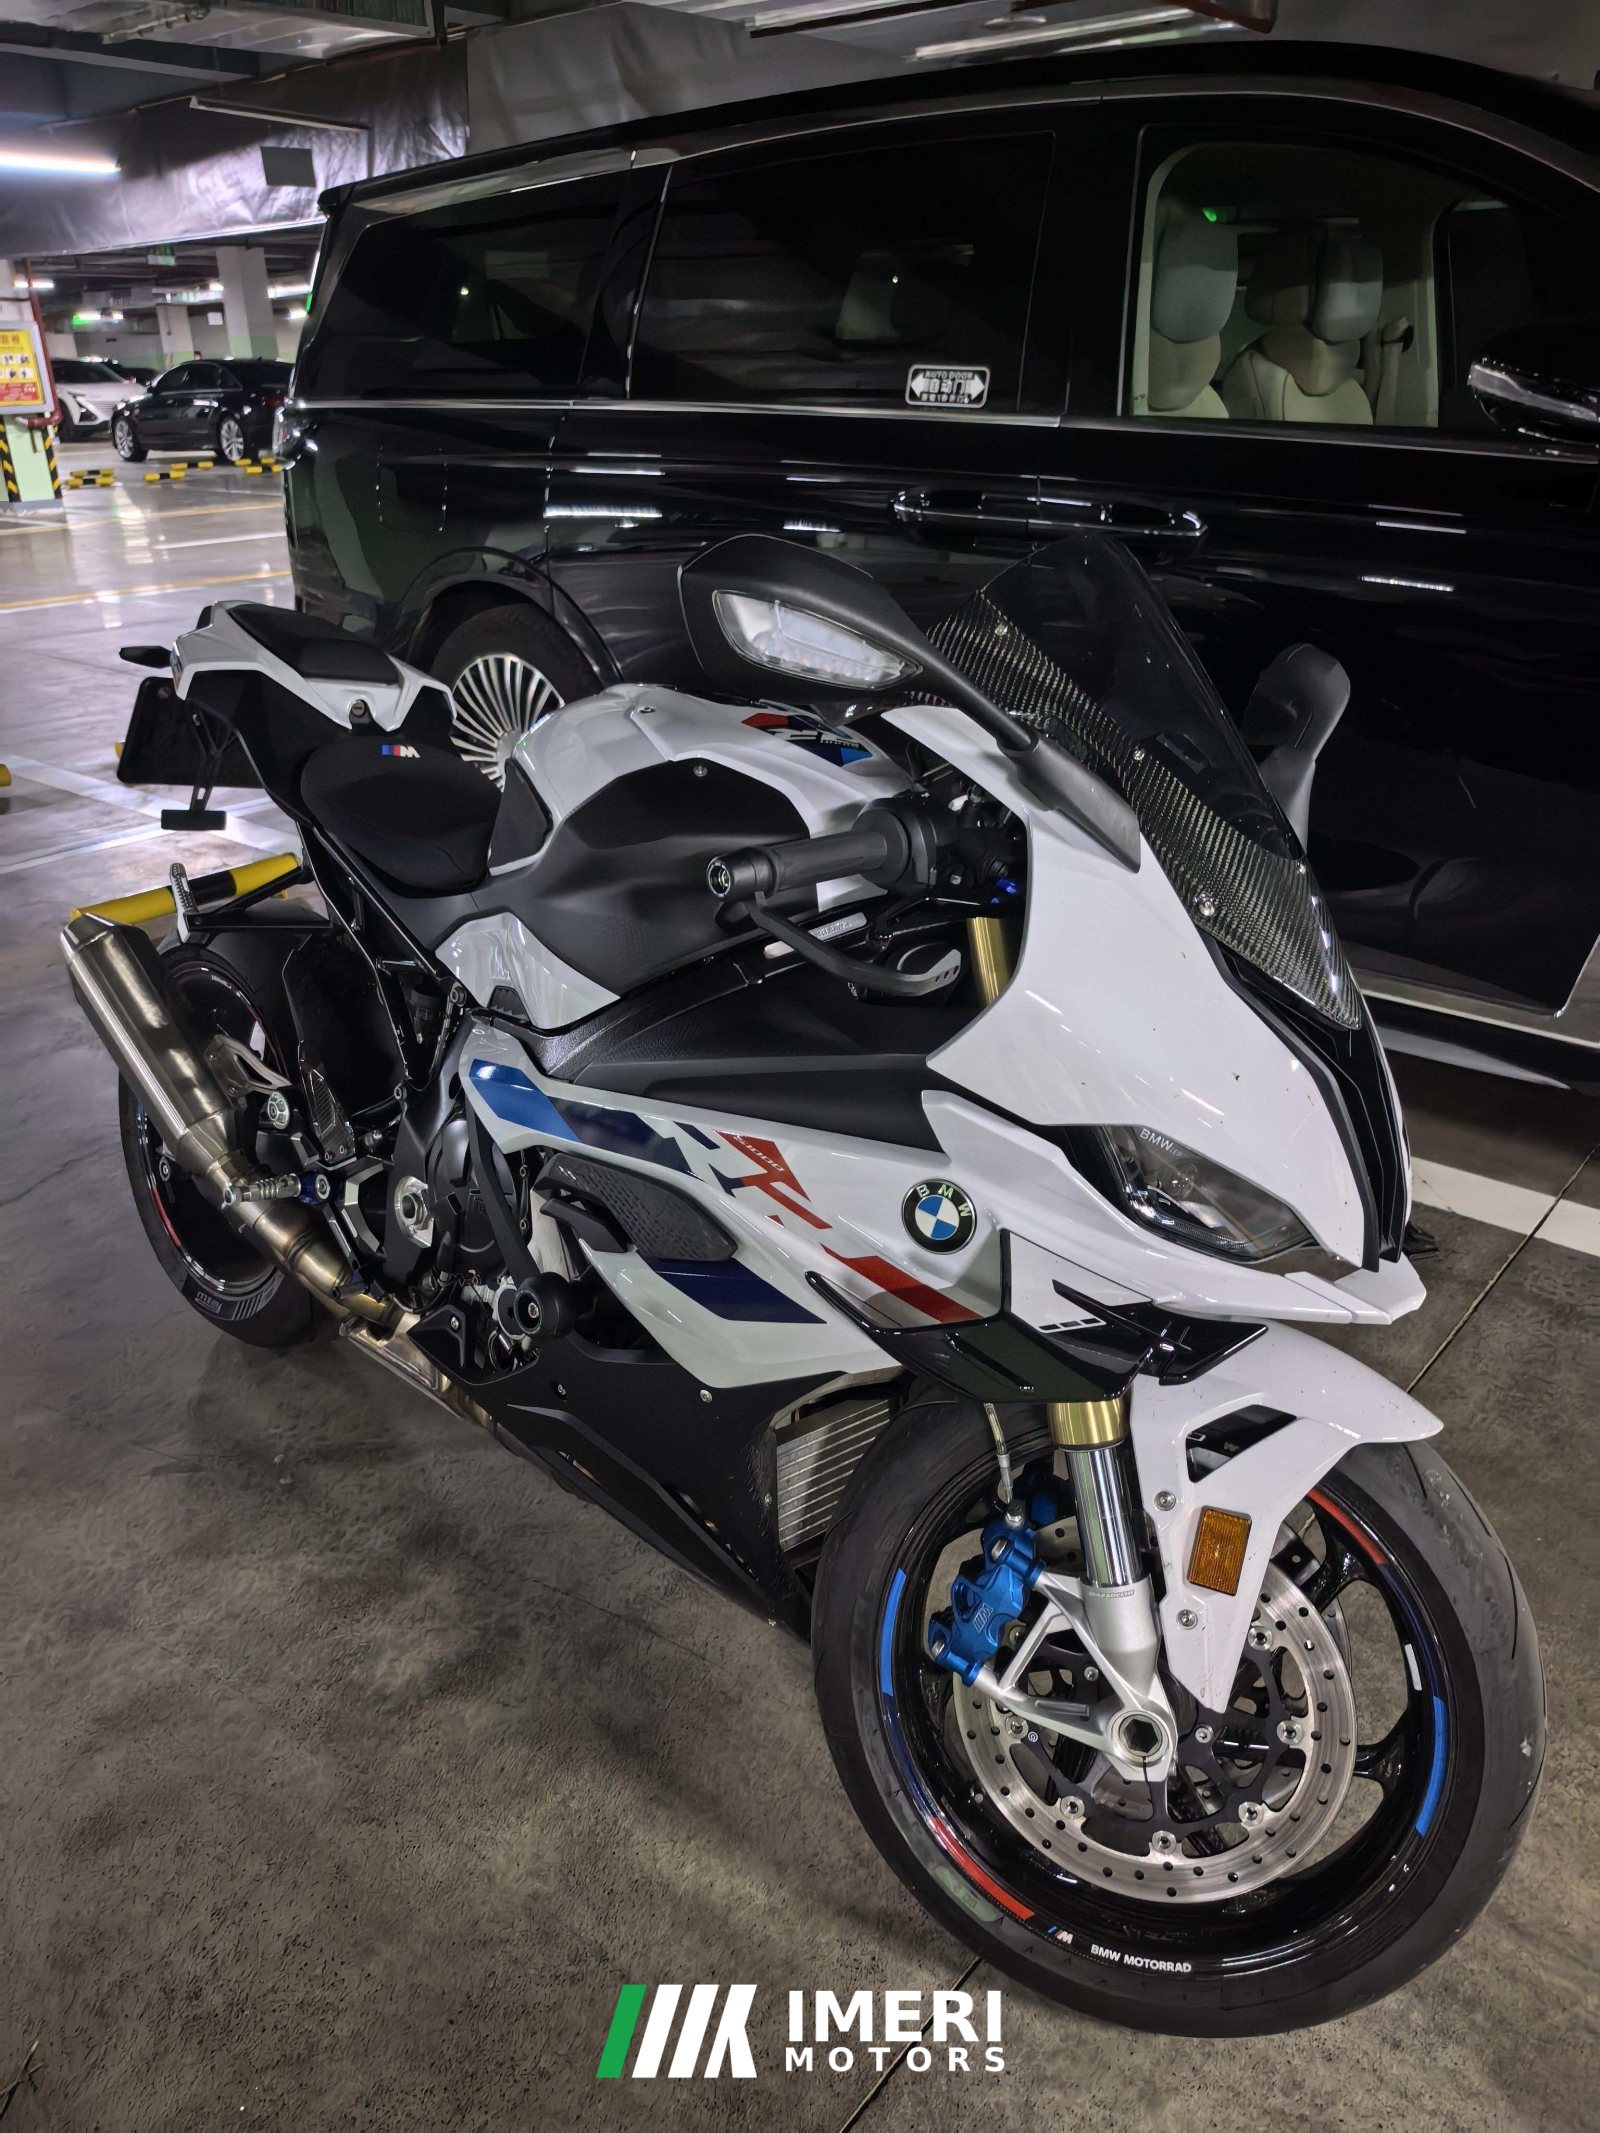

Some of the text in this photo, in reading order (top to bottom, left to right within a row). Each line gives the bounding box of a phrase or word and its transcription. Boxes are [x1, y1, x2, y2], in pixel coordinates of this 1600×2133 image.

[1139, 1127, 1174, 1151] BMW
[916, 1184, 972, 1217] BMW
[1090, 1943, 1192, 1973] BMW MOTORRAD
